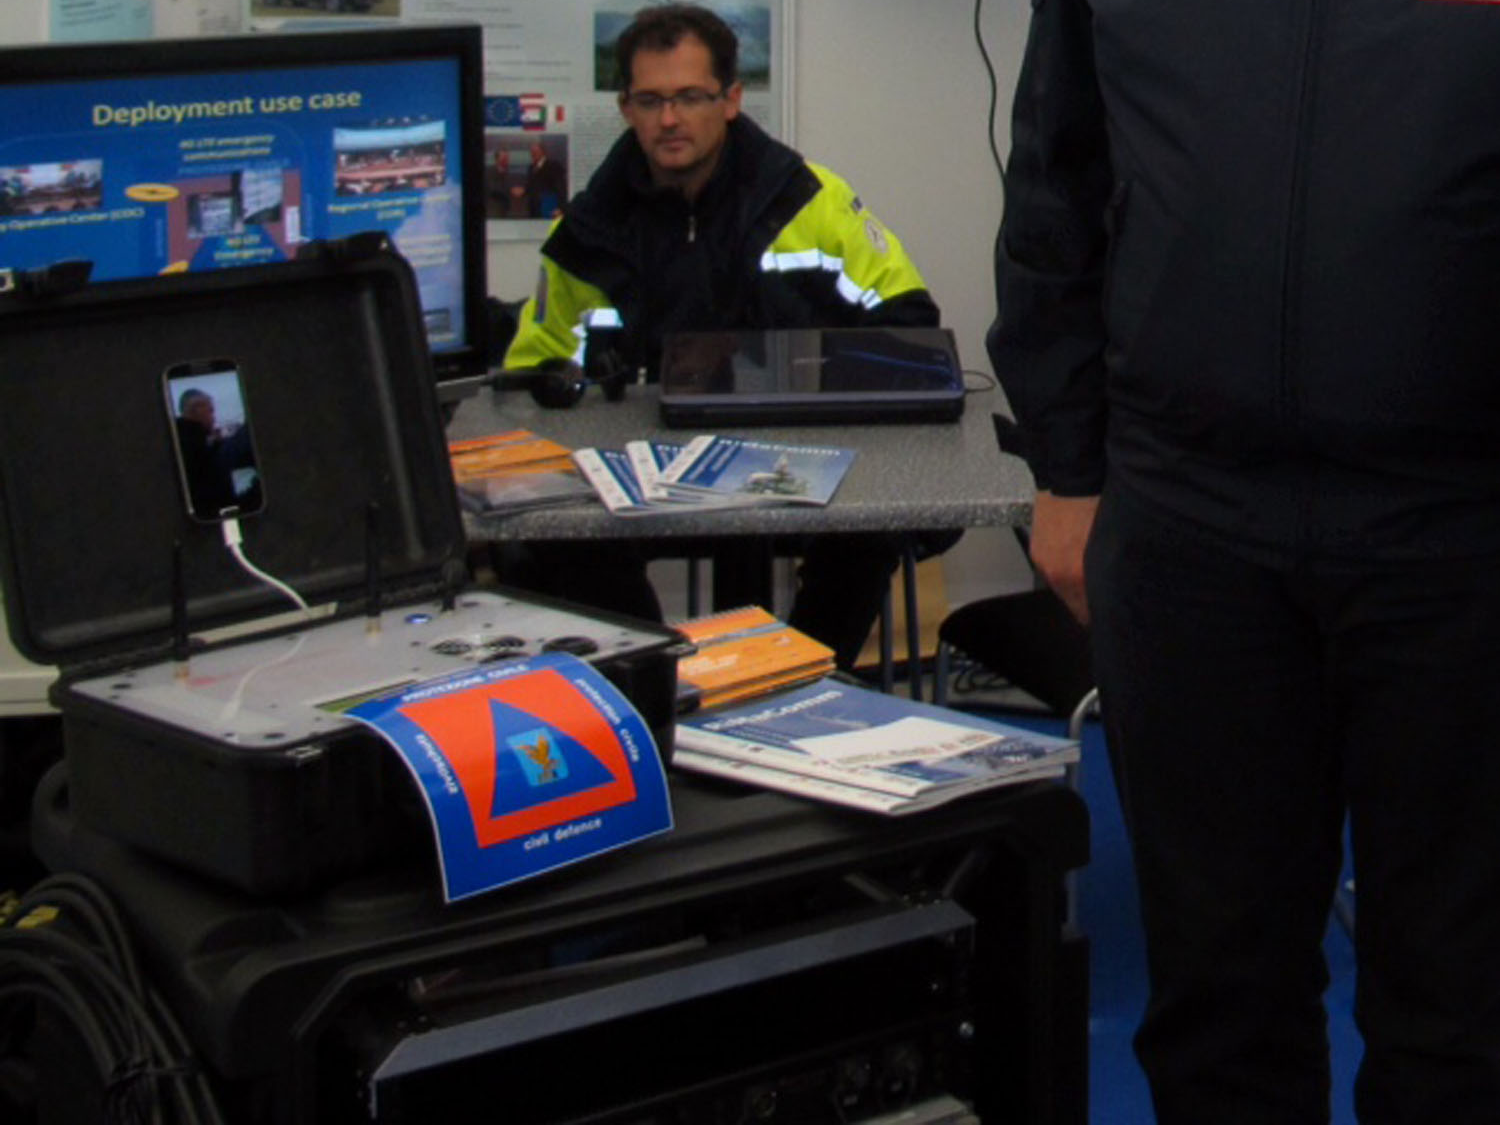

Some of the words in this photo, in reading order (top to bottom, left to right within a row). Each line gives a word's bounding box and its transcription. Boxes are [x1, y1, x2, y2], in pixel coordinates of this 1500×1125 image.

[92, 96, 254, 127] Deployment
[259, 95, 303, 113] use
[308, 91, 362, 110] case
[523, 832, 550, 851] civil
[554, 817, 602, 842] defence
